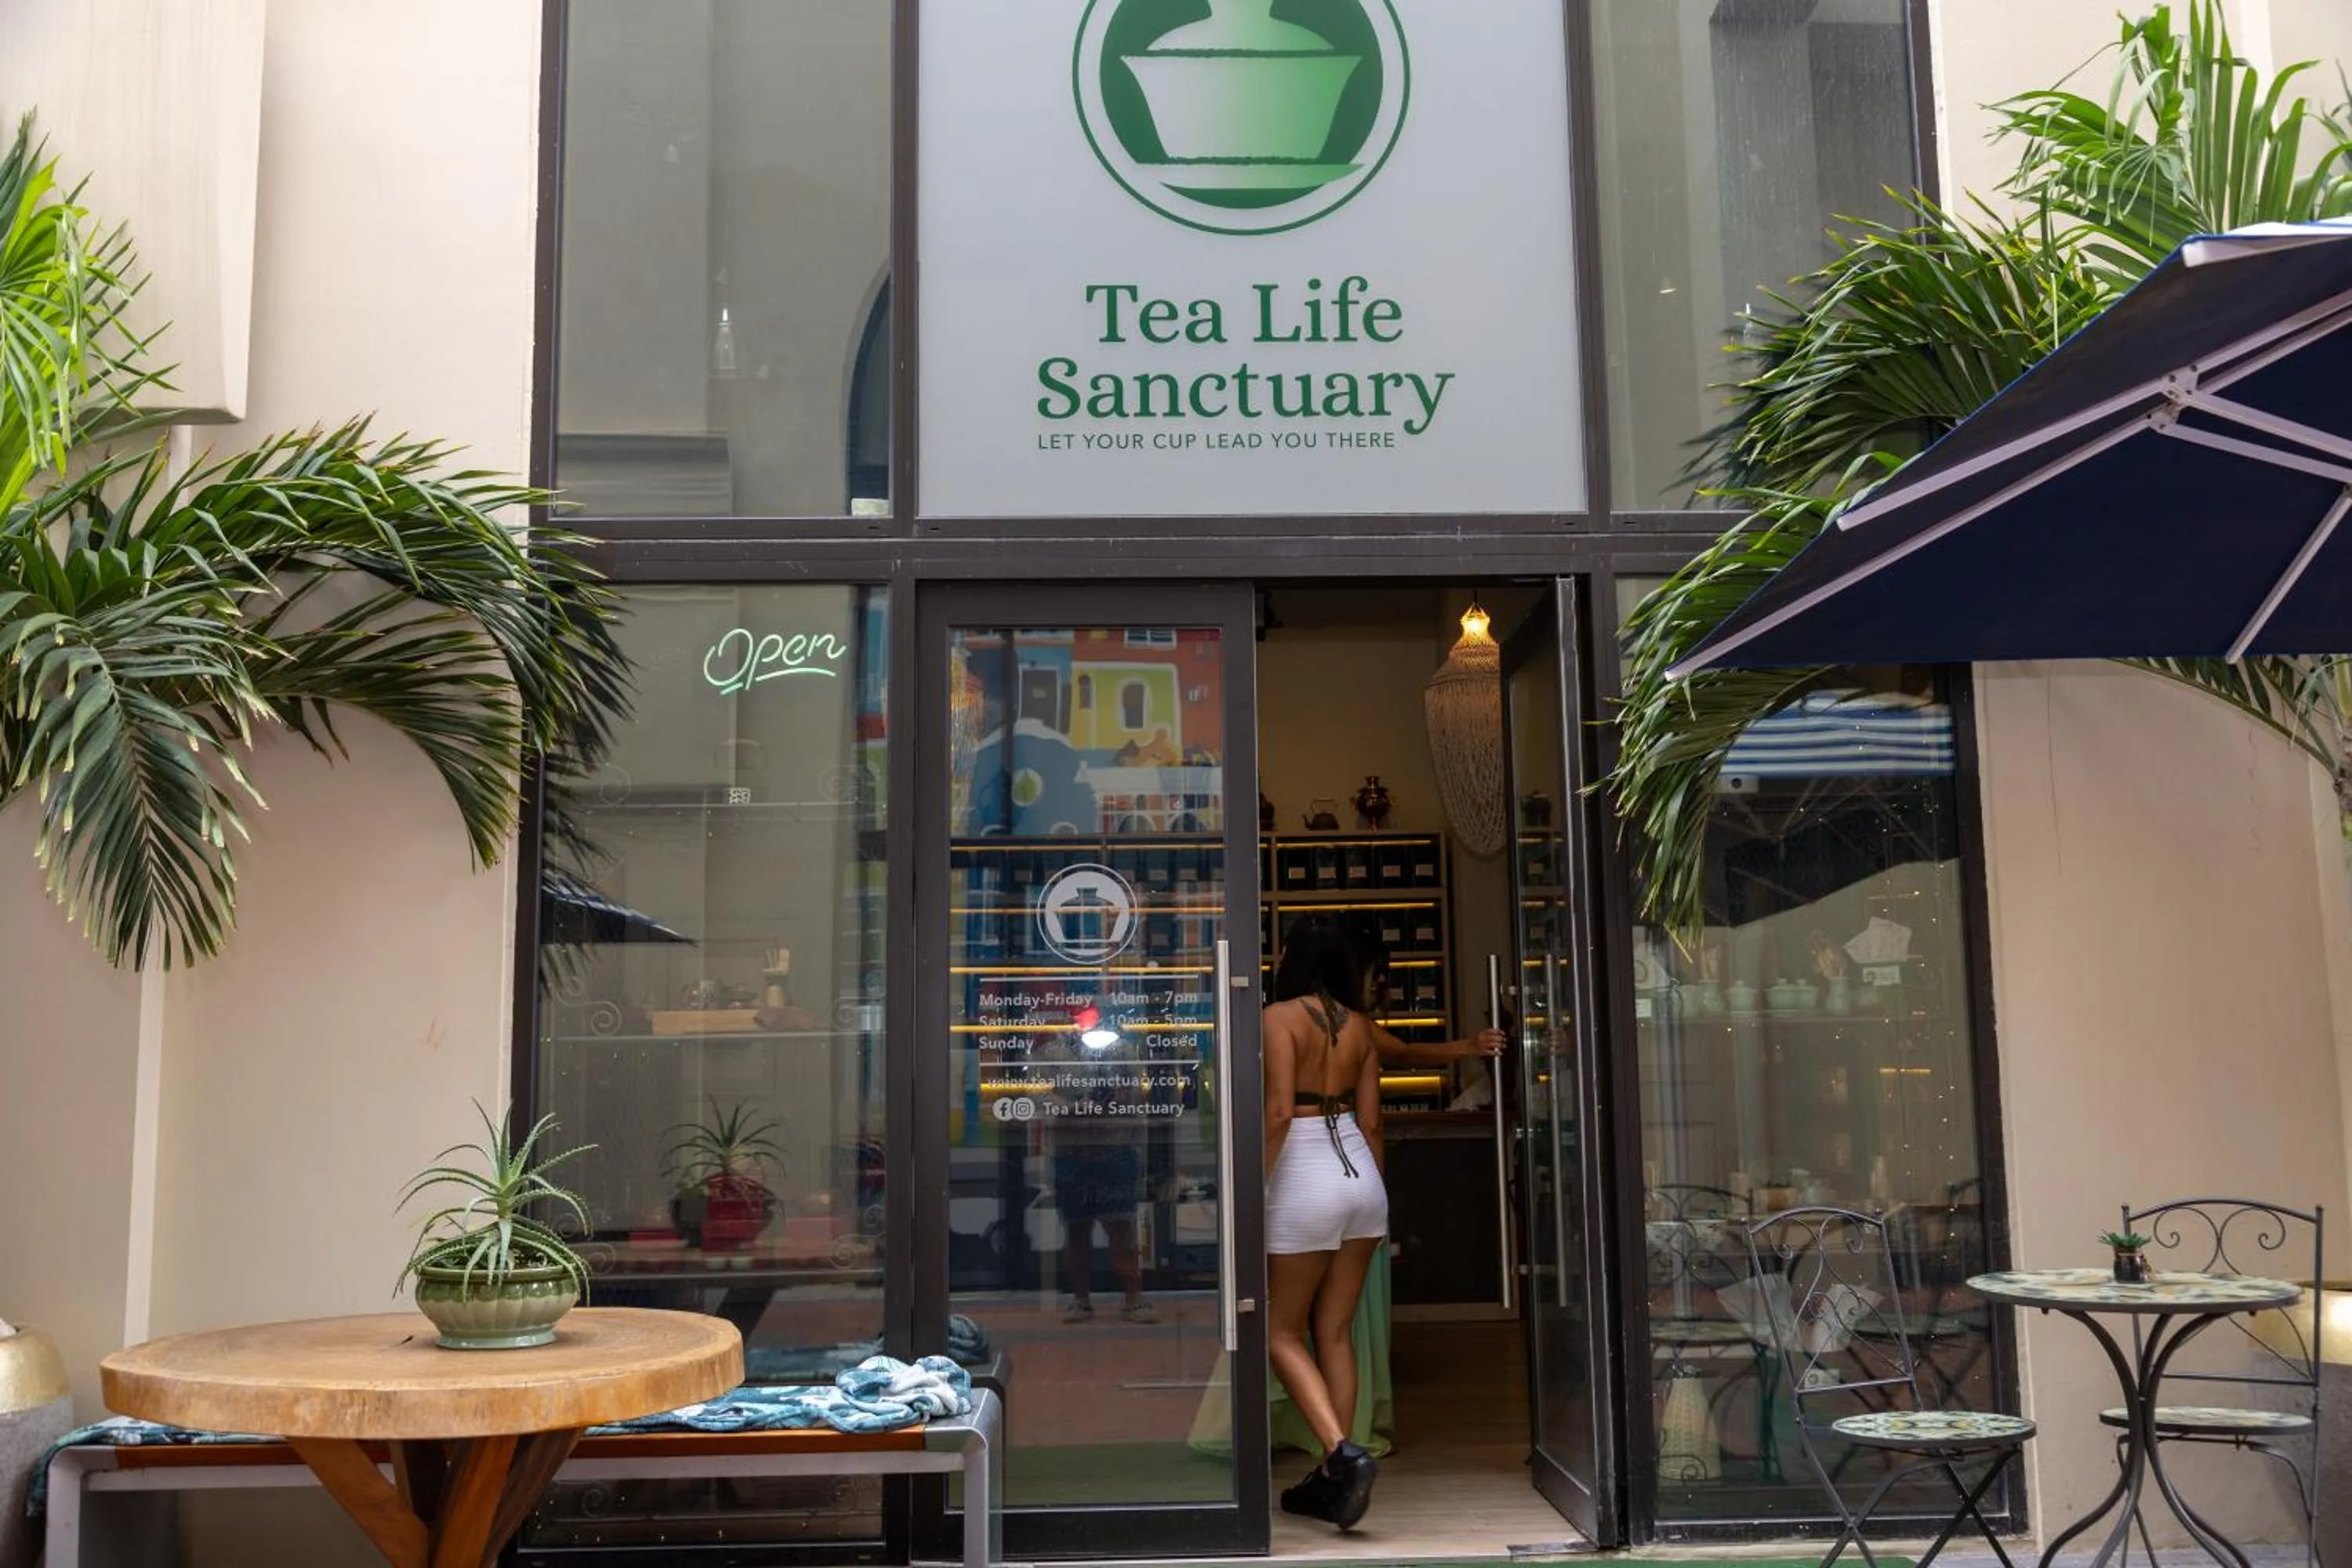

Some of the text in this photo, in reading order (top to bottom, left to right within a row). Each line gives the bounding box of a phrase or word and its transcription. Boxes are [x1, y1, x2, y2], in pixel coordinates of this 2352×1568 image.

[1086, 276, 1403, 343] Tea Life
[1037, 357, 1456, 435] Sanctuary
[1038, 432, 1395, 450] LET YOUR CUP LEAD YOU THERE
[703, 628, 847, 691] Open
[979, 993, 1092, 1008] Monday-Friday
[1111, 992, 1149, 1004] 10am
[1164, 990, 1198, 1007] 7pm
[979, 1014, 1046, 1028] Saturday
[979, 1033, 1197, 1053] Sunday Closed
[1043, 1100, 1185, 1117] Tea Life Sanctuary
